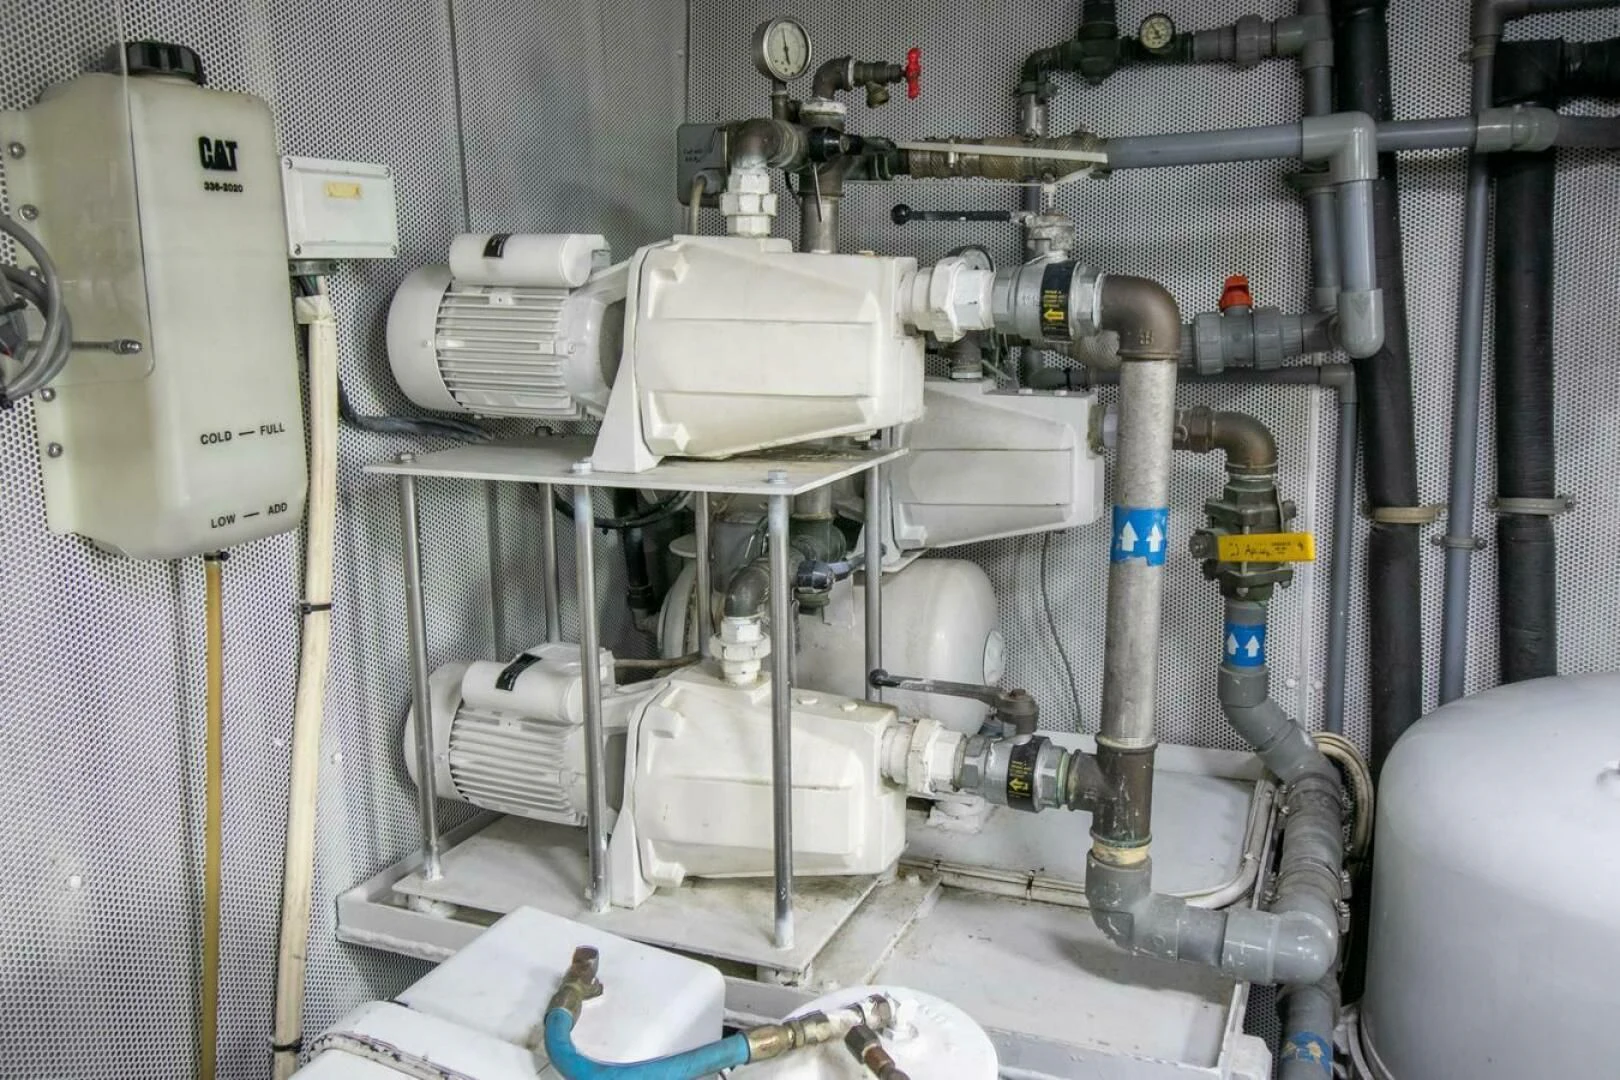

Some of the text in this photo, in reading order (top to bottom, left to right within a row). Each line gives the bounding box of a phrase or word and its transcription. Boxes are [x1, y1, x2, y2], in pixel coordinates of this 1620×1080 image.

[198, 136, 238, 172] CAT
[200, 422, 286, 445] COLD FULL
[210, 502, 288, 529] LOW ADD
